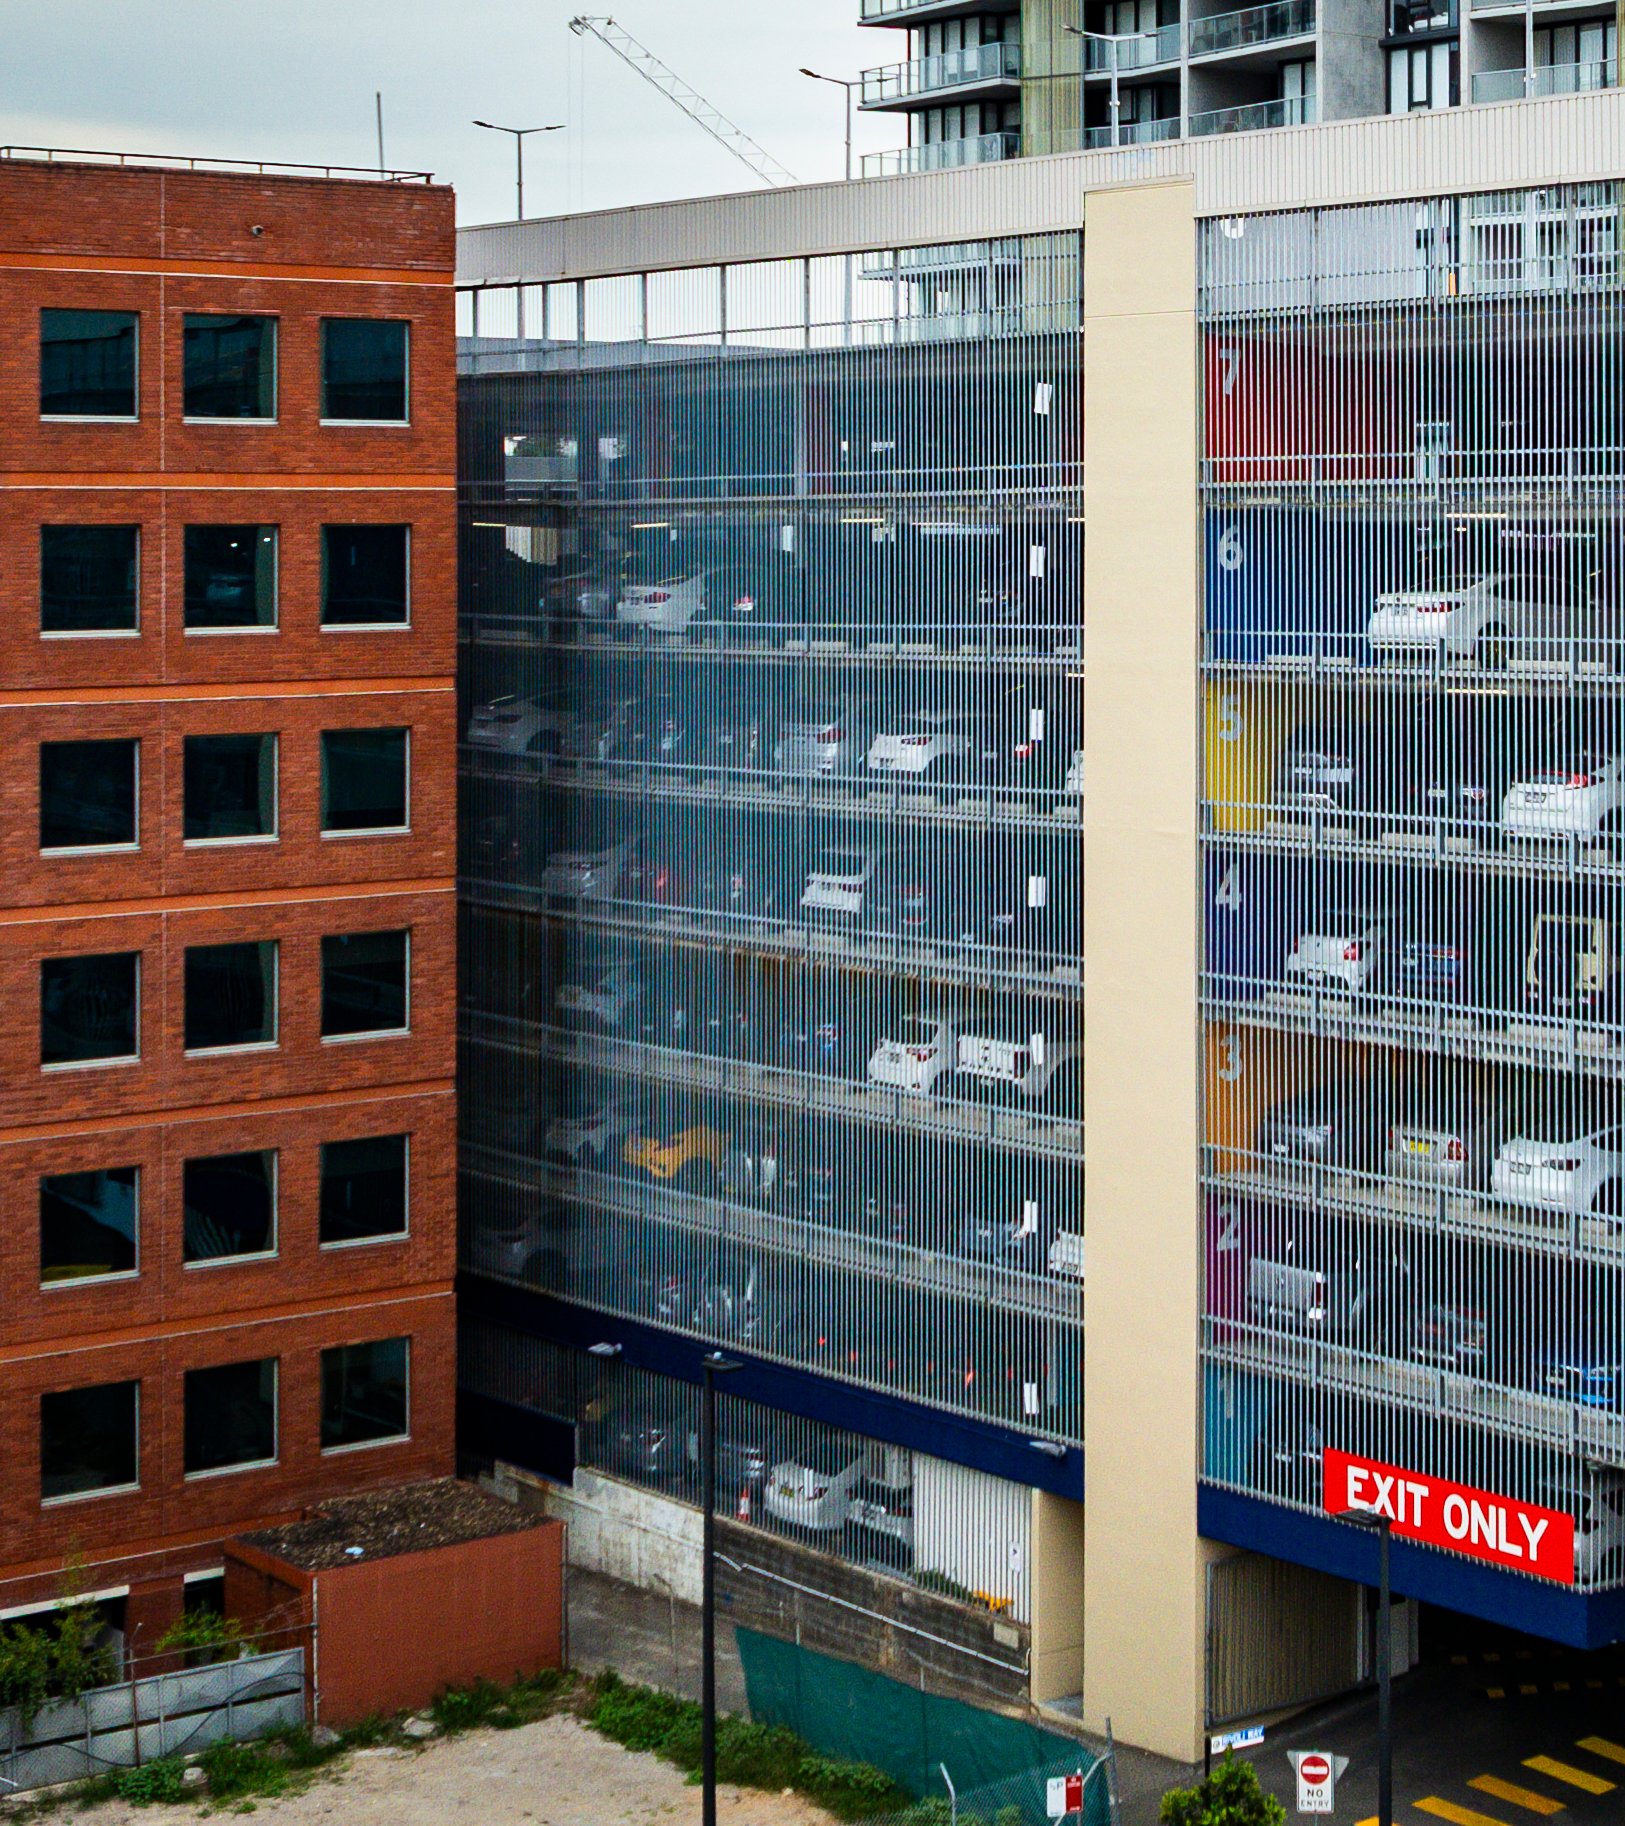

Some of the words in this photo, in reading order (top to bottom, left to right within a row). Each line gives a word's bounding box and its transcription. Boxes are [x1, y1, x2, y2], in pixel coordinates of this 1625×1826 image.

[1219, 349, 1241, 394] 7
[1219, 524, 1243, 570] 6
[1220, 695, 1242, 741] 5
[1216, 864, 1242, 910] 4
[1218, 1034, 1242, 1081] 3
[1217, 1204, 1240, 1251] 2
[1347, 1464, 1429, 1528] EXIT
[1443, 1493, 1549, 1562] ONLY
[1300, 1799, 1330, 1808] ENTRY
[1306, 1788, 1324, 1797] NO
